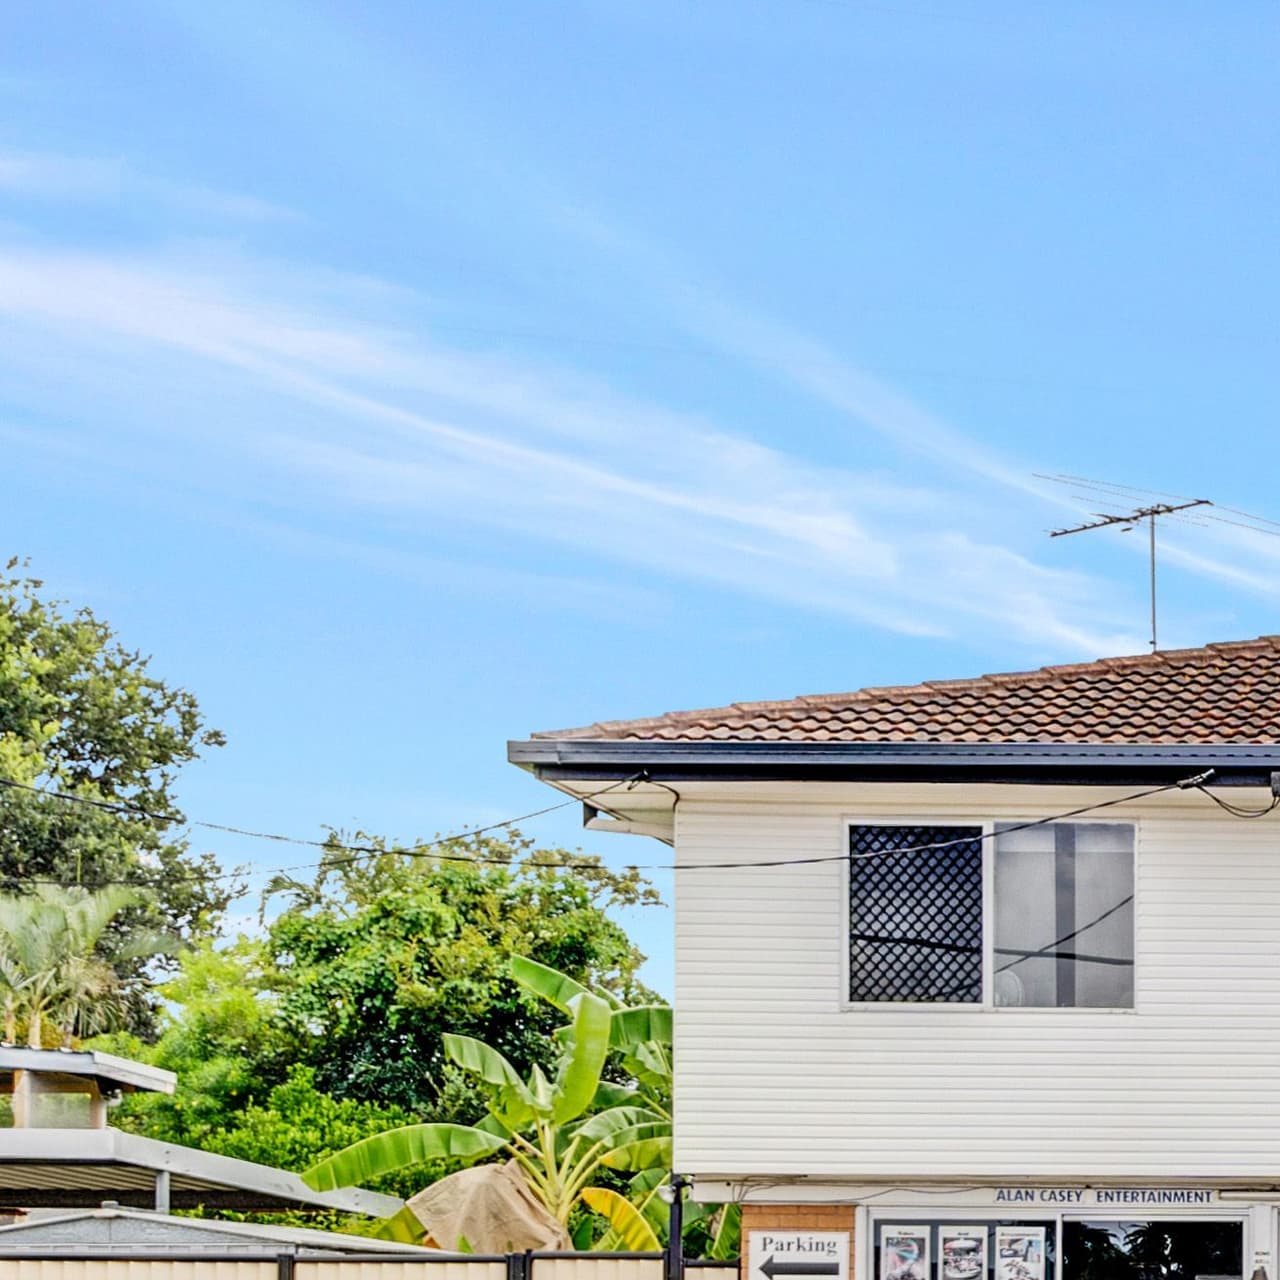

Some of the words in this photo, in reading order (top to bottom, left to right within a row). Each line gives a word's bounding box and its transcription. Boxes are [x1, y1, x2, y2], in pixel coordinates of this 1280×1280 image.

[996, 1189, 1034, 1202] ALAN
[1039, 1189, 1083, 1202] CASEY
[1096, 1190, 1212, 1204] ENTERTAINMENT
[761, 1236, 837, 1256] Parking
